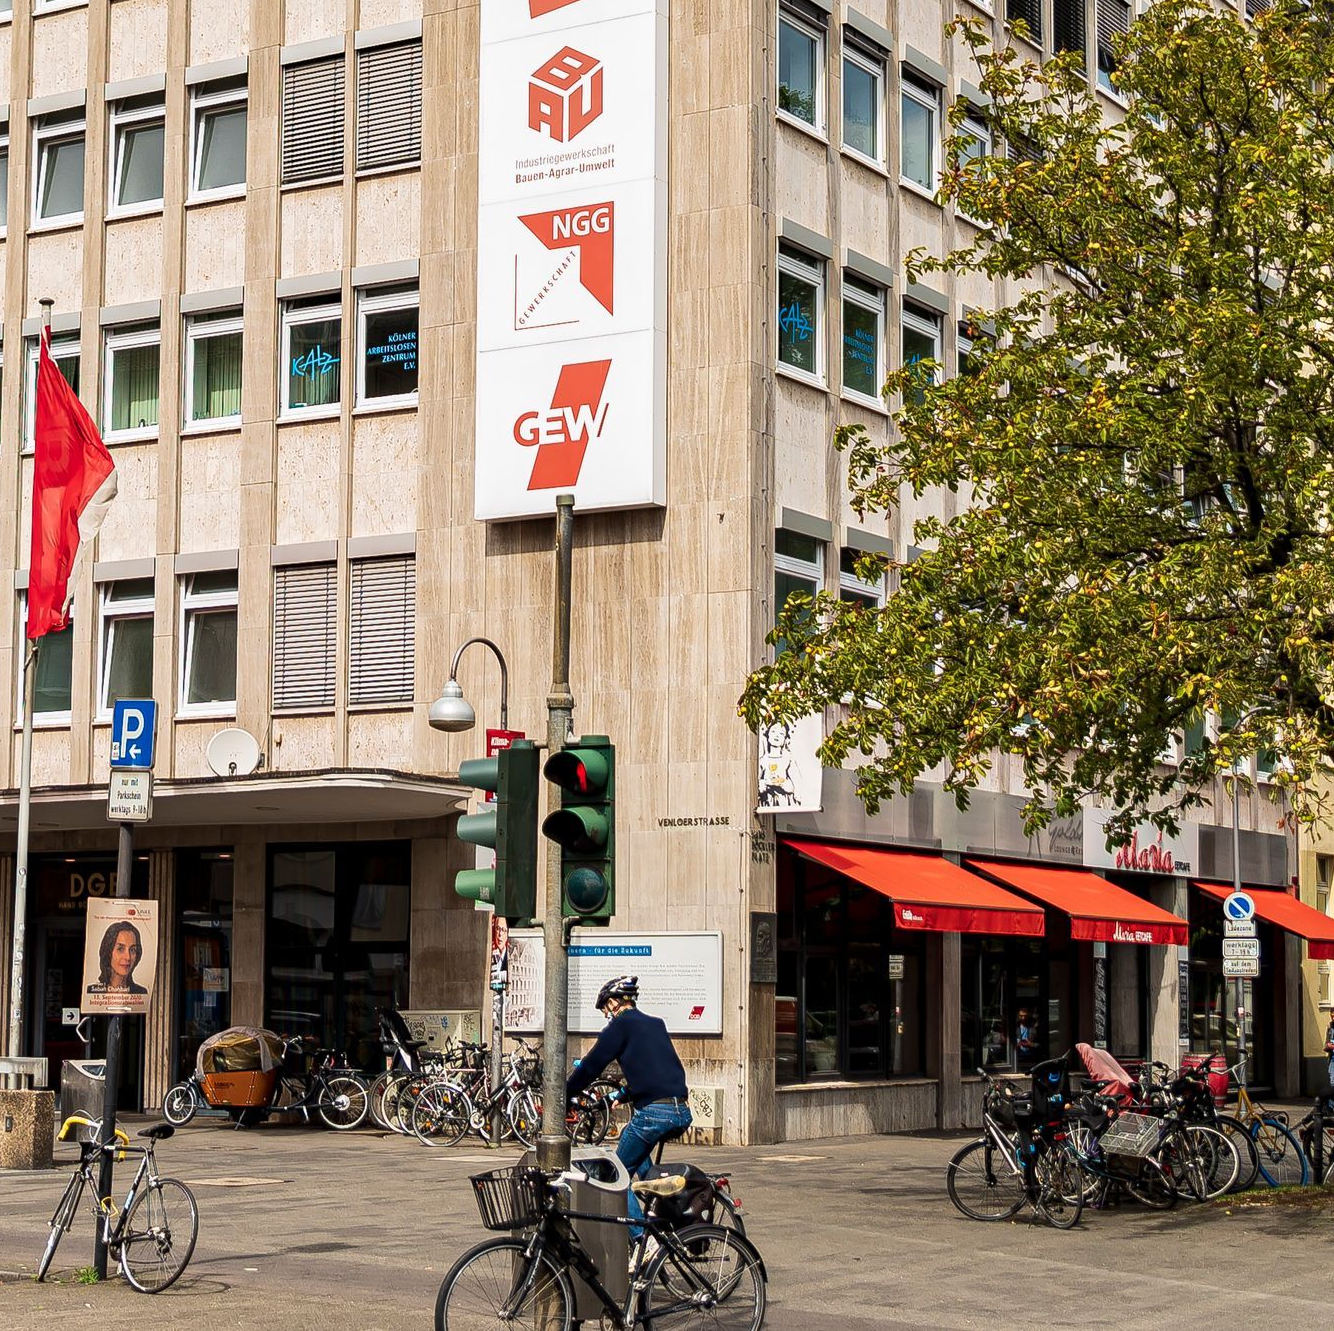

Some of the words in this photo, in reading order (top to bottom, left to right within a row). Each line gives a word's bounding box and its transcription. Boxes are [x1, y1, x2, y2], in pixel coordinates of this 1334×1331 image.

[515, 144, 615, 170] Industriegewerkschaft
[515, 159, 615, 184] Bauen-Agrar-Umwelt
[552, 207, 610, 240] NGG
[519, 250, 578, 325] GEWERKSCHAFT
[388, 332, 416, 343] KÖLNER
[367, 342, 416, 355] ARBEITSLOSEN
[382, 352, 416, 363] ZENTRUM
[404, 362, 416, 370] E.V.
[513, 403, 609, 447] GEW
[121, 708, 145, 758] P
[121, 778, 129, 786] nur
[130, 778, 139, 786] mit
[117, 791, 141, 800] Parkschein
[111, 806, 131, 815] werktags
[658, 816, 729, 827] VENLOERSTRASSE
[1116, 830, 1174, 873] Maria
[1113, 920, 1135, 943] Maria
[594, 946, 605, 955] für
[621, 946, 650, 955] Zukunft
[1227, 941, 1256, 949] werktags
[102, 994, 130, 1003] September
